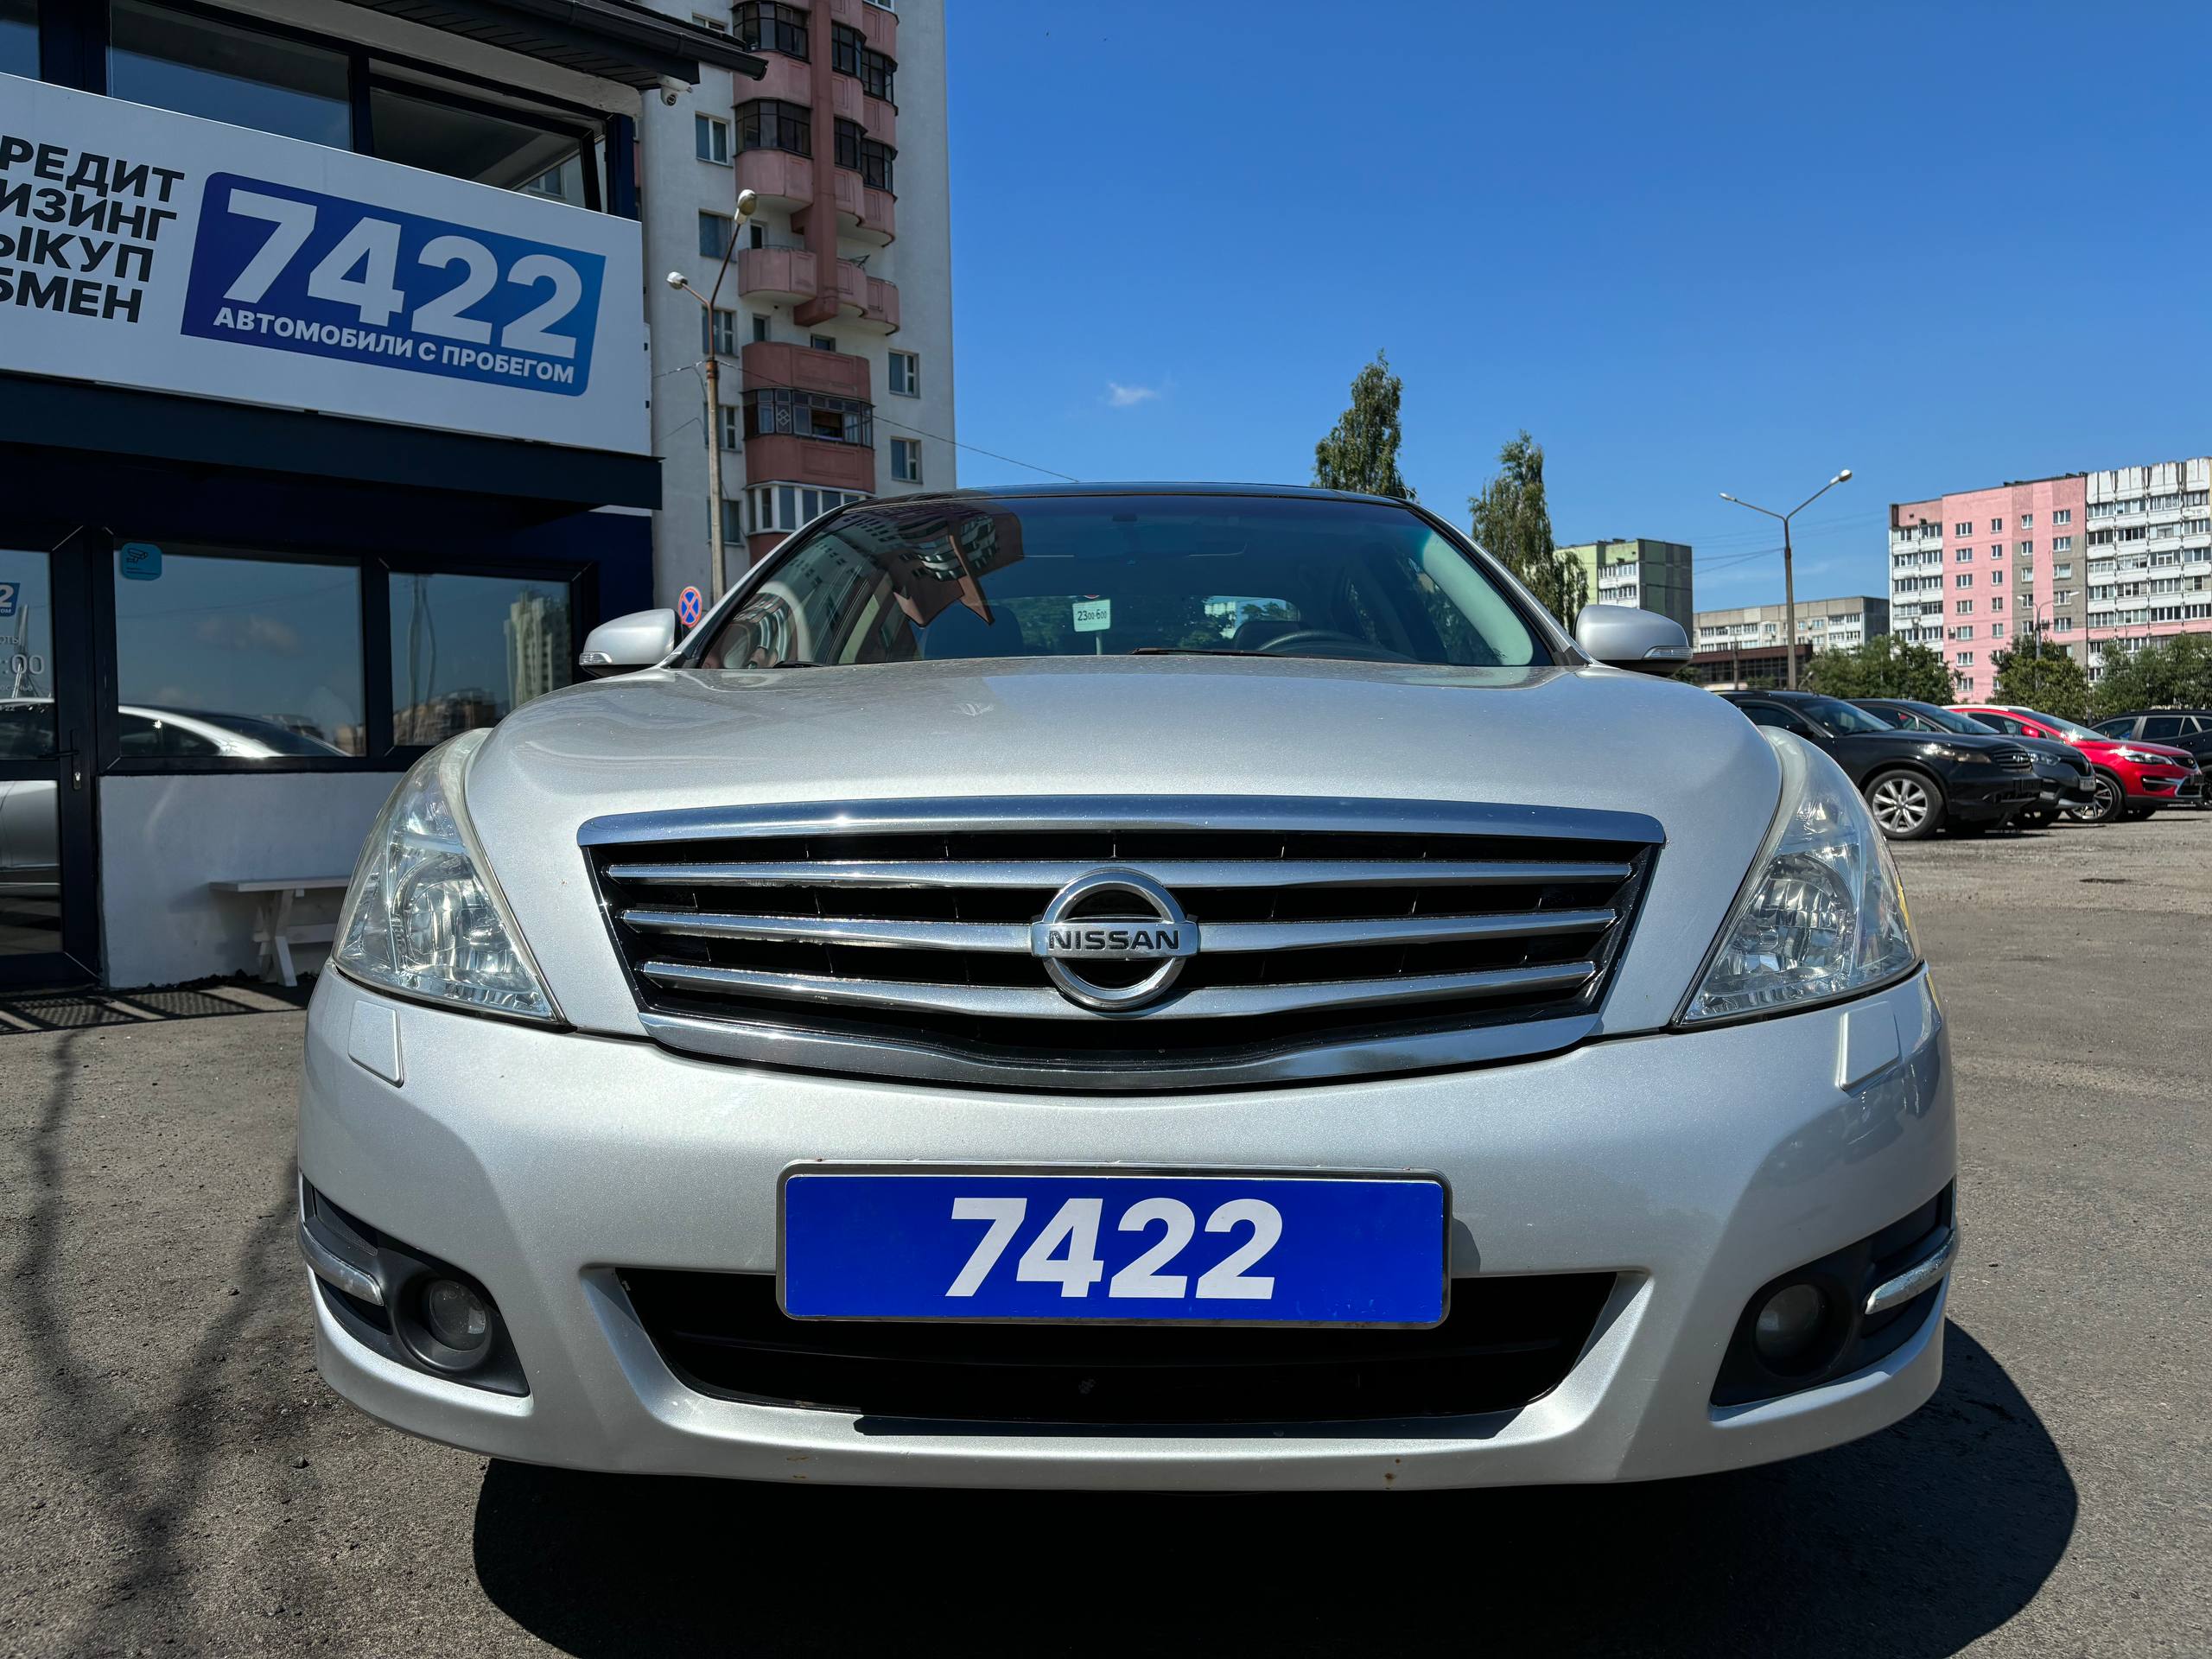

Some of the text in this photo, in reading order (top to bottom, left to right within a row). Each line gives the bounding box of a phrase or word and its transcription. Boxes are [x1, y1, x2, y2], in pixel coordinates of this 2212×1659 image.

[0, 135, 185, 202] РЕДИТ
[223, 188, 582, 359] 7422
[213, 307, 575, 385] АВТОМОБИЛИ С ПРОБЕГОМ
[1049, 930, 1179, 950] NISSAN
[944, 1197, 1283, 1300] 7422
